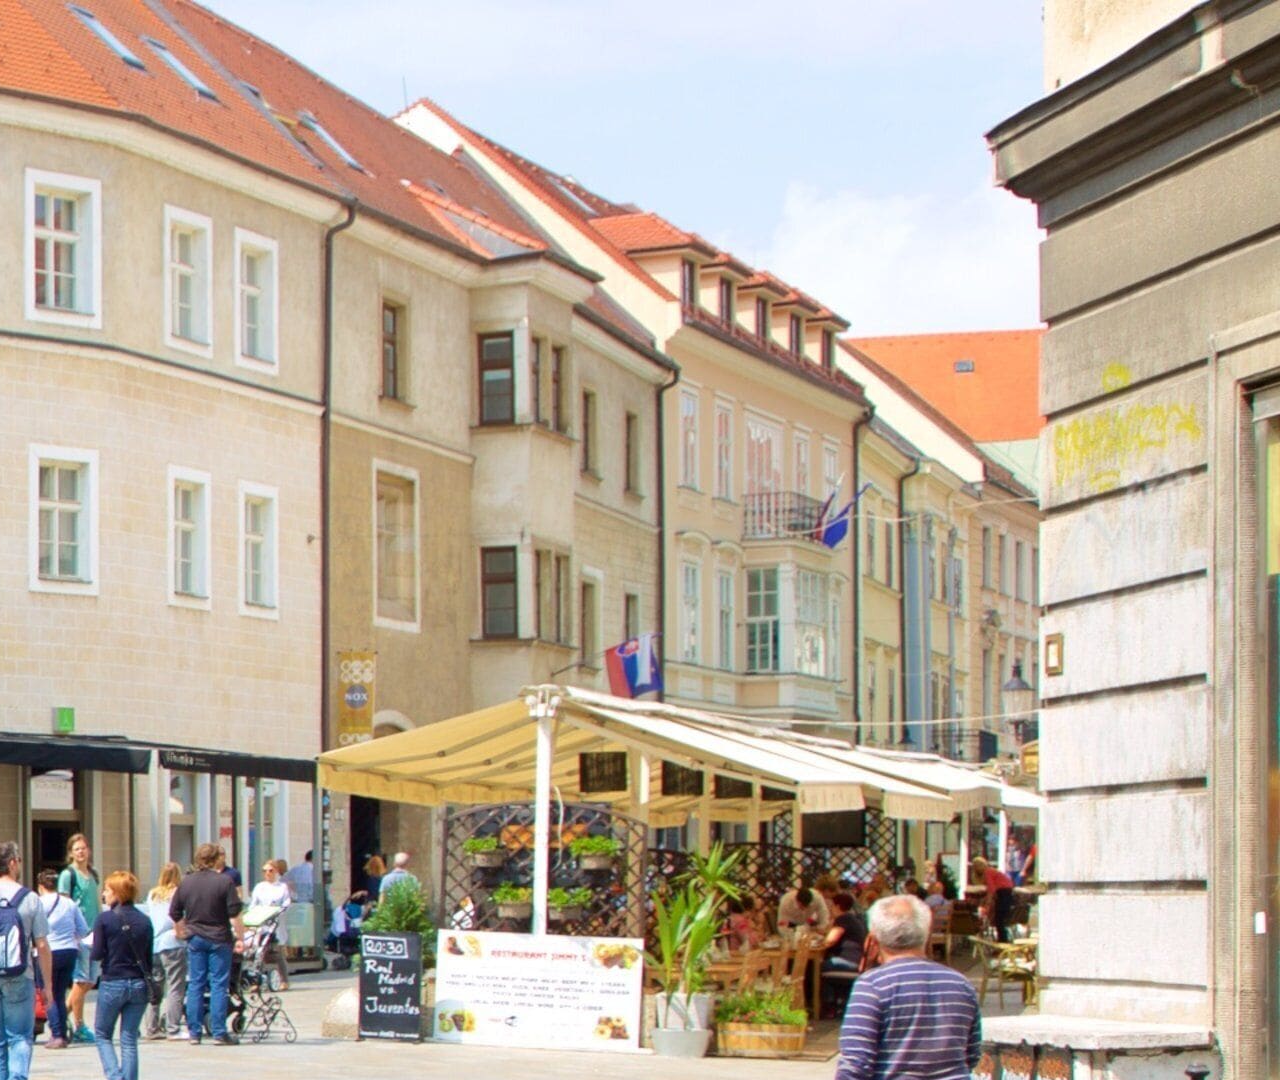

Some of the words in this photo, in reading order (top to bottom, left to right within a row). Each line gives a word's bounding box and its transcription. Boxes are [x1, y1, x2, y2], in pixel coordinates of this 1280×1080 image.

[344, 693, 368, 701] NOX
[365, 939, 404, 955] 20:30
[364, 959, 393, 974] Real
[377, 972, 416, 986] Madrid
[365, 996, 420, 1015] Juventus
